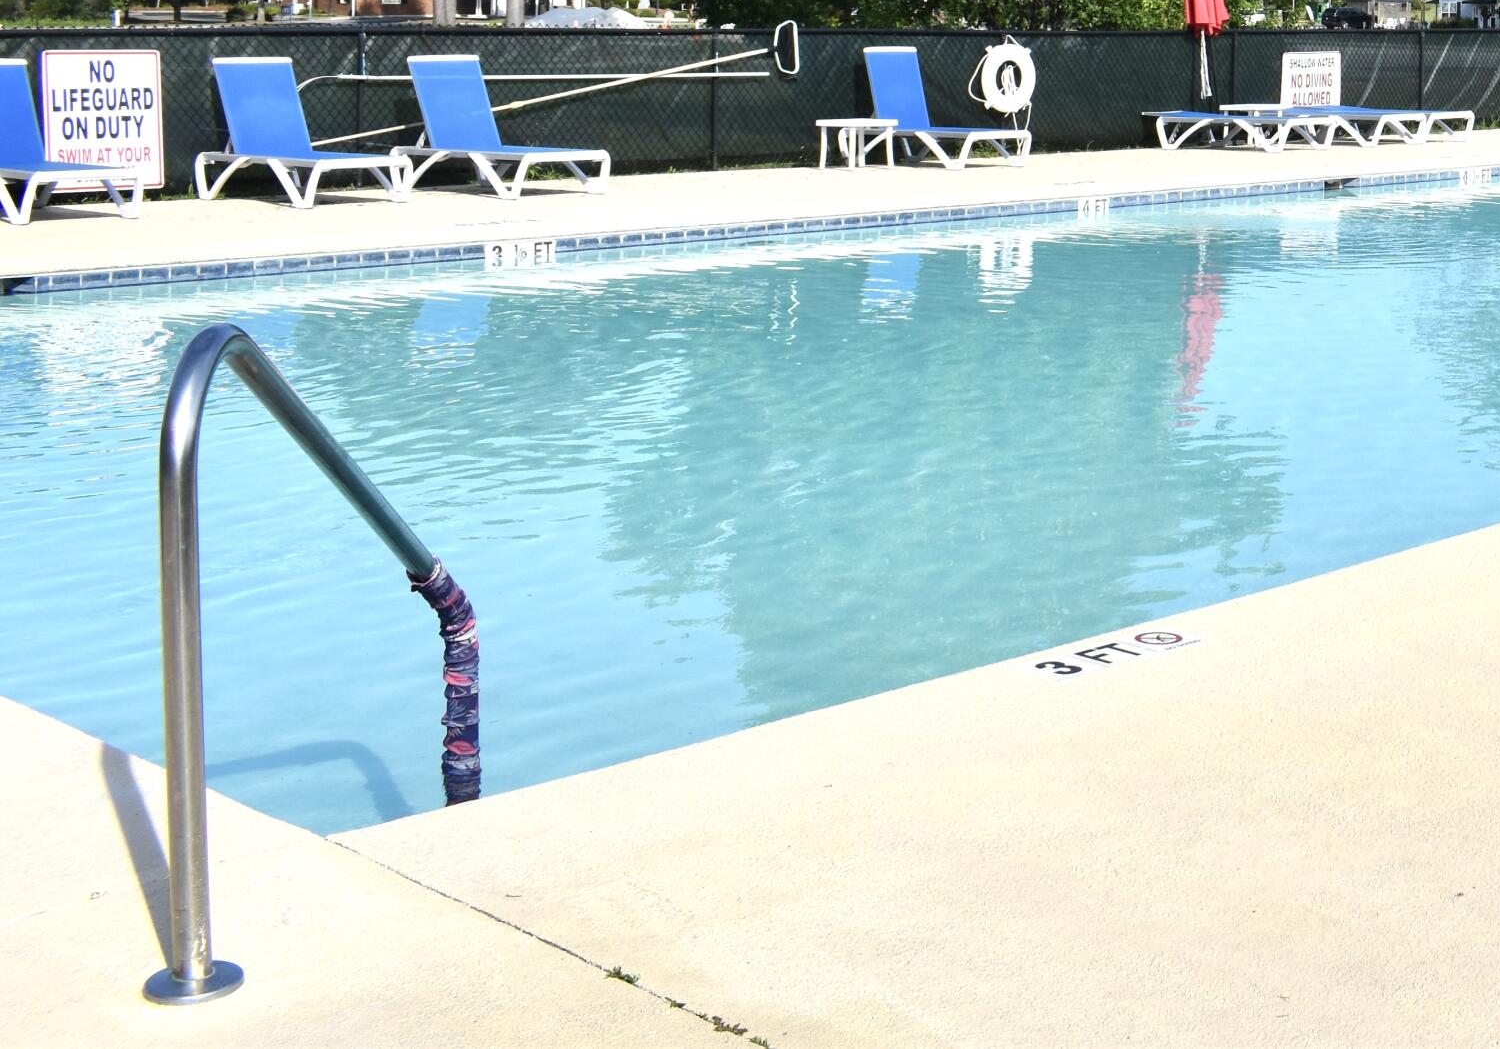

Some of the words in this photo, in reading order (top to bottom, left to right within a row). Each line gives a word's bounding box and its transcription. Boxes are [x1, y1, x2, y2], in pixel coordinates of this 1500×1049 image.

[89, 60, 115, 83] NO
[1289, 58, 1316, 69] SHALLOW
[1317, 57, 1335, 68] WATER
[1291, 73, 1303, 89] NO
[1305, 72, 1333, 88] DIVING
[52, 87, 154, 112] LIFEGUARD
[1292, 91, 1331, 106] ALLOWED
[62, 116, 88, 140] ON
[96, 115, 144, 139] DUTY
[57, 149, 92, 163] SWIM
[97, 148, 112, 163] AT
[117, 147, 151, 163] YOUR
[534, 241, 553, 258] FT
[1035, 661, 1083, 675] 3
[1073, 642, 1142, 664] FT
